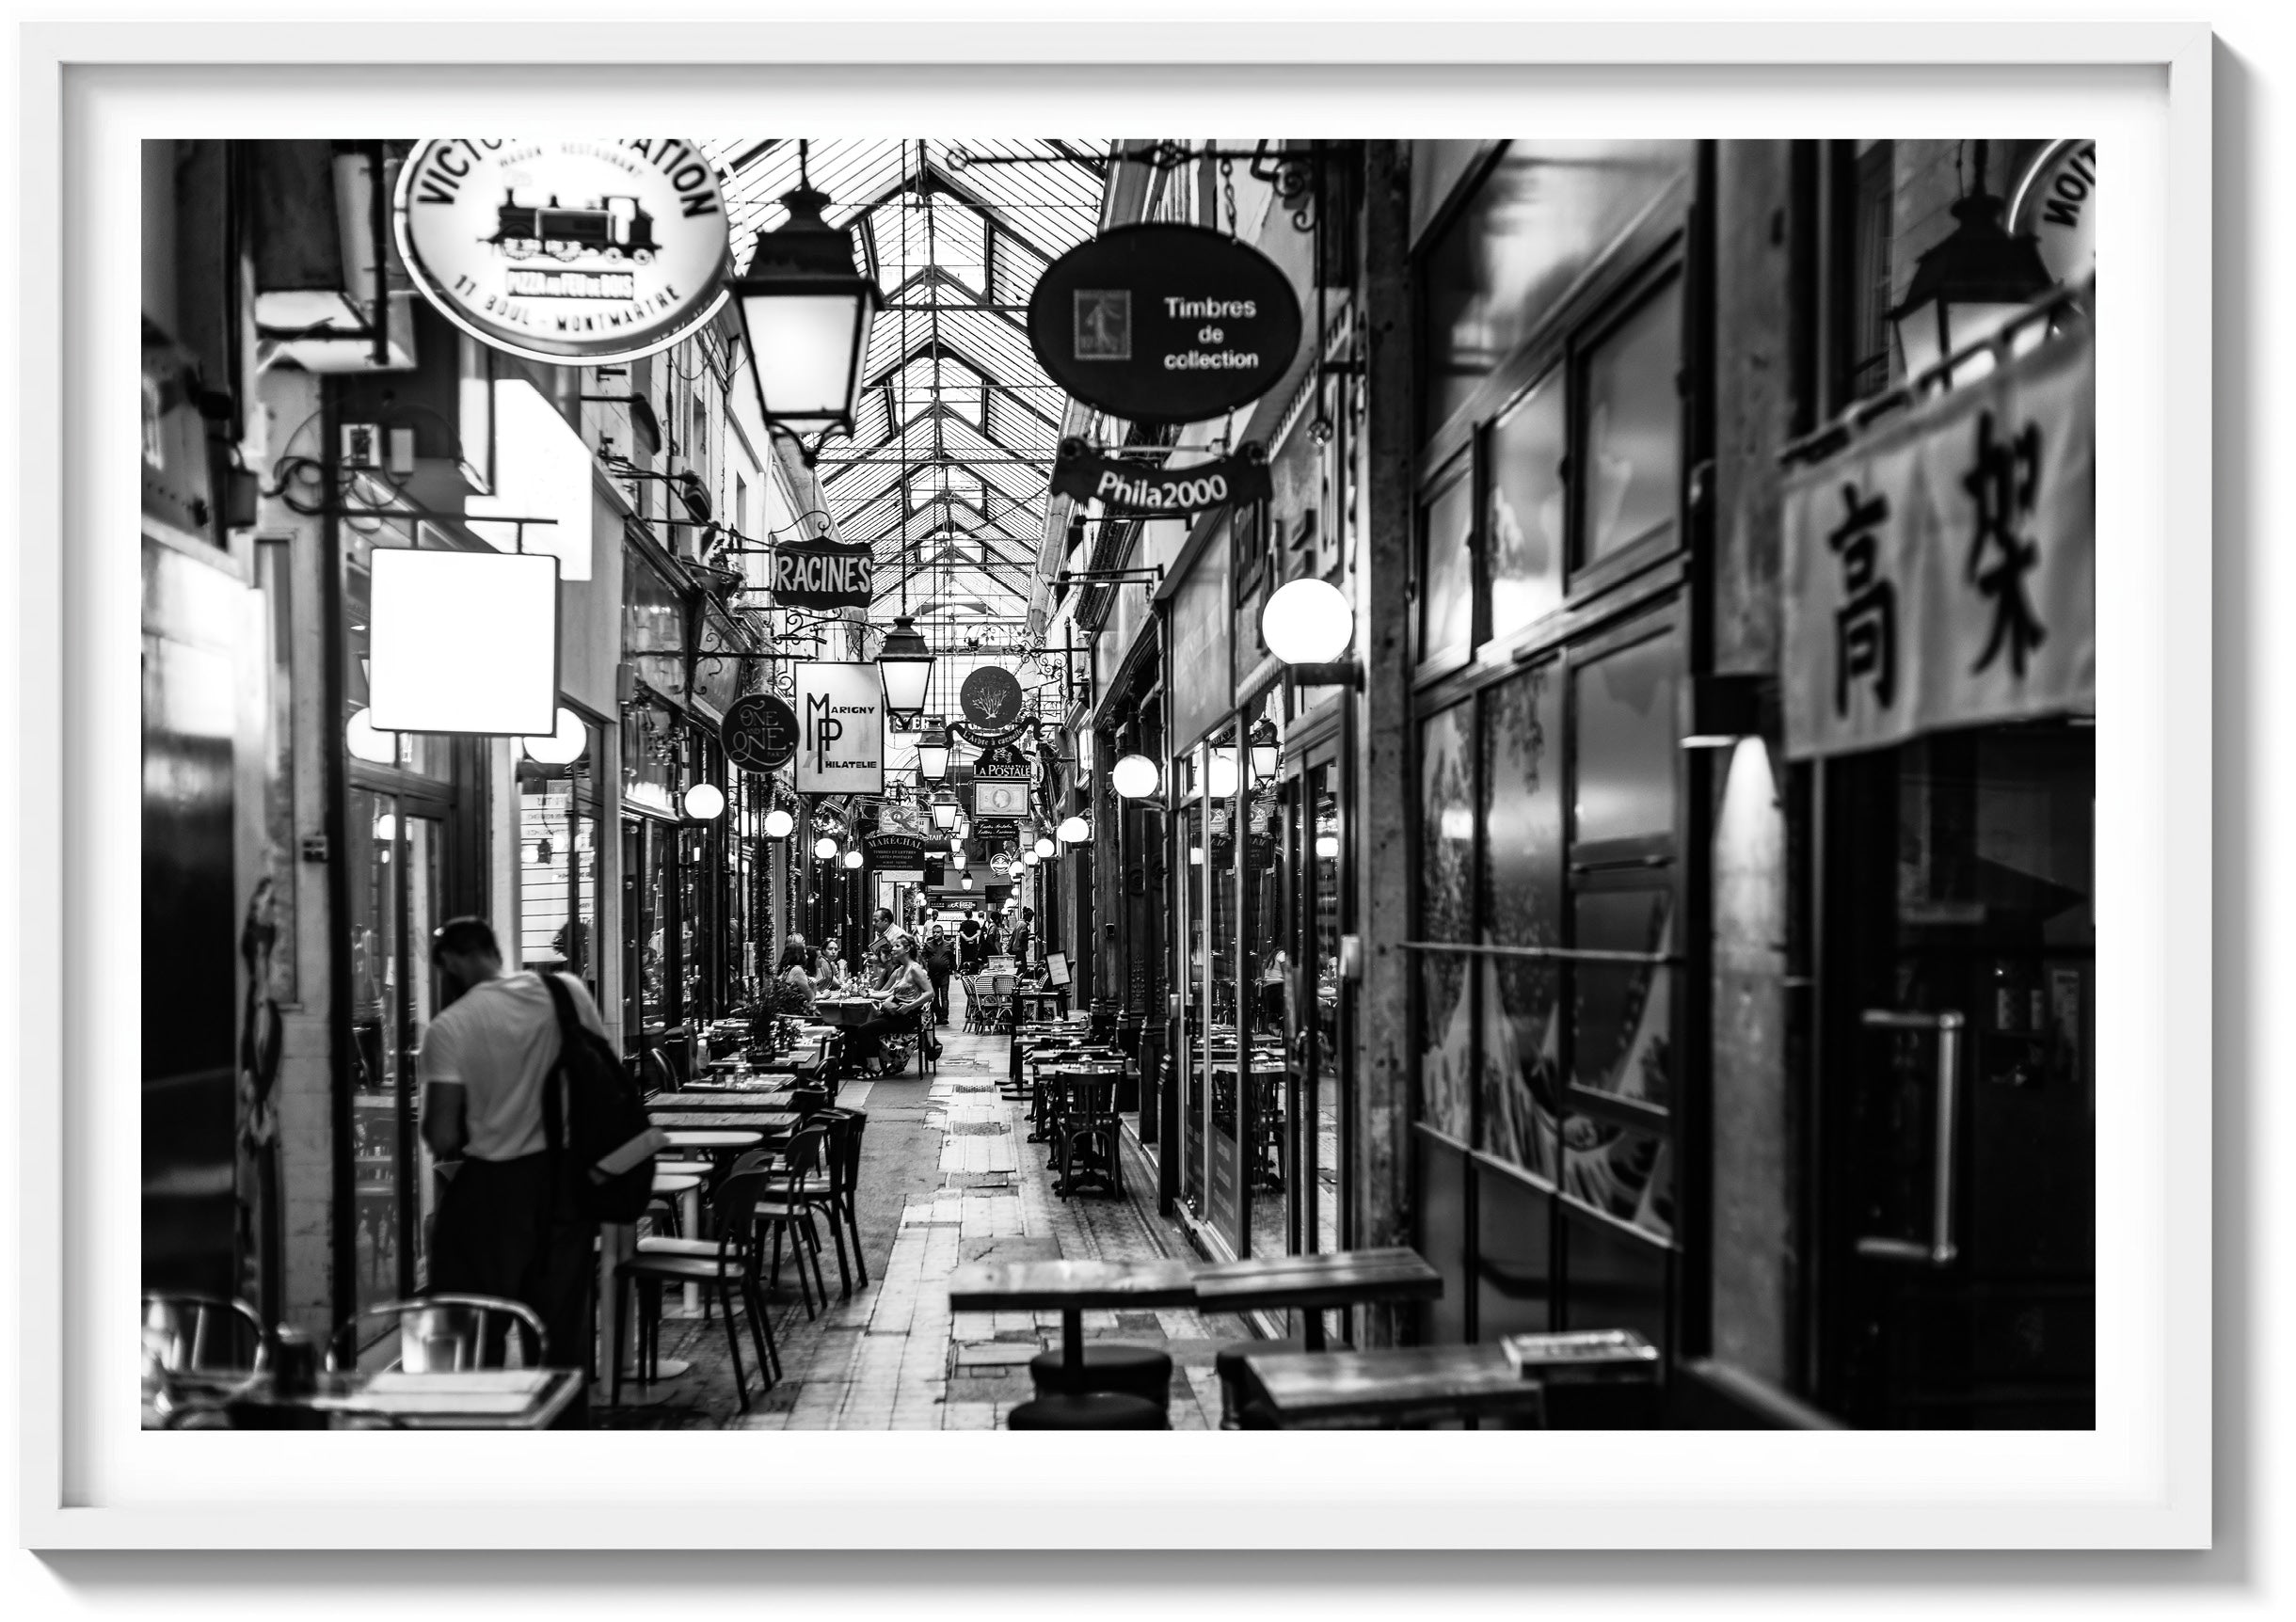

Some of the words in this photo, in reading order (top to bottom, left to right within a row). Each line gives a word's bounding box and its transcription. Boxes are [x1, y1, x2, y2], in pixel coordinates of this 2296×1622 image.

[555, 284, 680, 331] MONTMARTRE
[1163, 296, 1257, 318] Timbres
[1197, 325, 1225, 344] de
[1163, 350, 1259, 370] collection
[1096, 470, 1229, 509] Phila2000
[777, 556, 871, 593] RACINES
[739, 704, 779, 727] ONE
[731, 727, 789, 755] ONE
[963, 730, 989, 746] L'Arbre
[997, 728, 1024, 745] cannelle
[973, 765, 986, 775] LA
[988, 765, 1031, 776] POSTALE
[868, 835, 922, 851] MARÉCHAL
